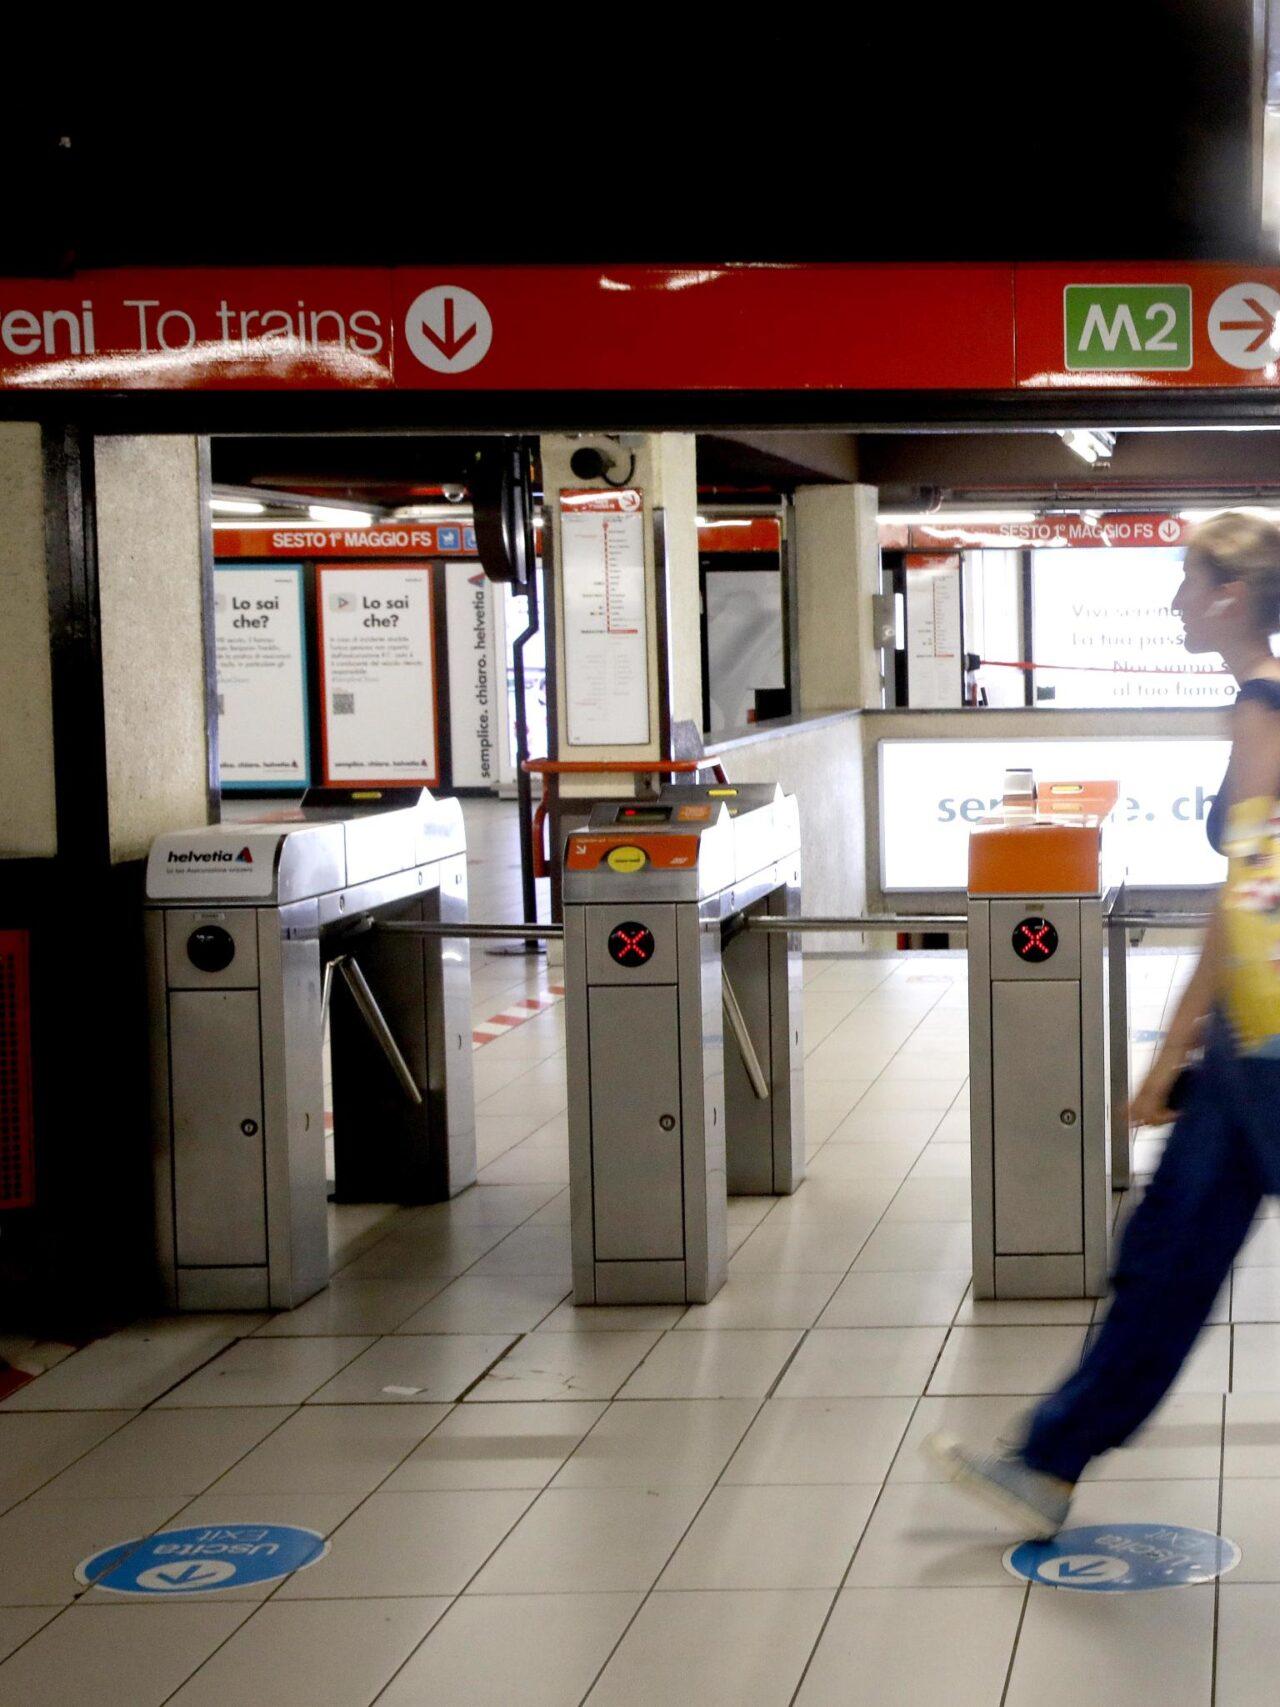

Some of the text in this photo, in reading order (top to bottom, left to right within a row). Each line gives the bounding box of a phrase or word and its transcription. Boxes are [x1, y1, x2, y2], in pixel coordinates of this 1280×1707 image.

[0, 300, 384, 356] eni To trains
[1078, 303, 1178, 351] M2
[999, 524, 1050, 539] SESTO
[1069, 524, 1131, 539] MAGGIO
[1134, 524, 1153, 538] FS
[272, 532, 327, 548] SESTO
[345, 532, 409, 548] MAGGIO
[411, 532, 432, 547] FS
[232, 596, 279, 610] Lo sai
[363, 595, 409, 610] Lo sai
[232, 614, 270, 629] che?
[363, 614, 399, 628] che?
[473, 591, 492, 778] semplice. chiaro. helvetia
[167, 850, 233, 863] helvetia
[152, 1543, 281, 1556] Uscita
